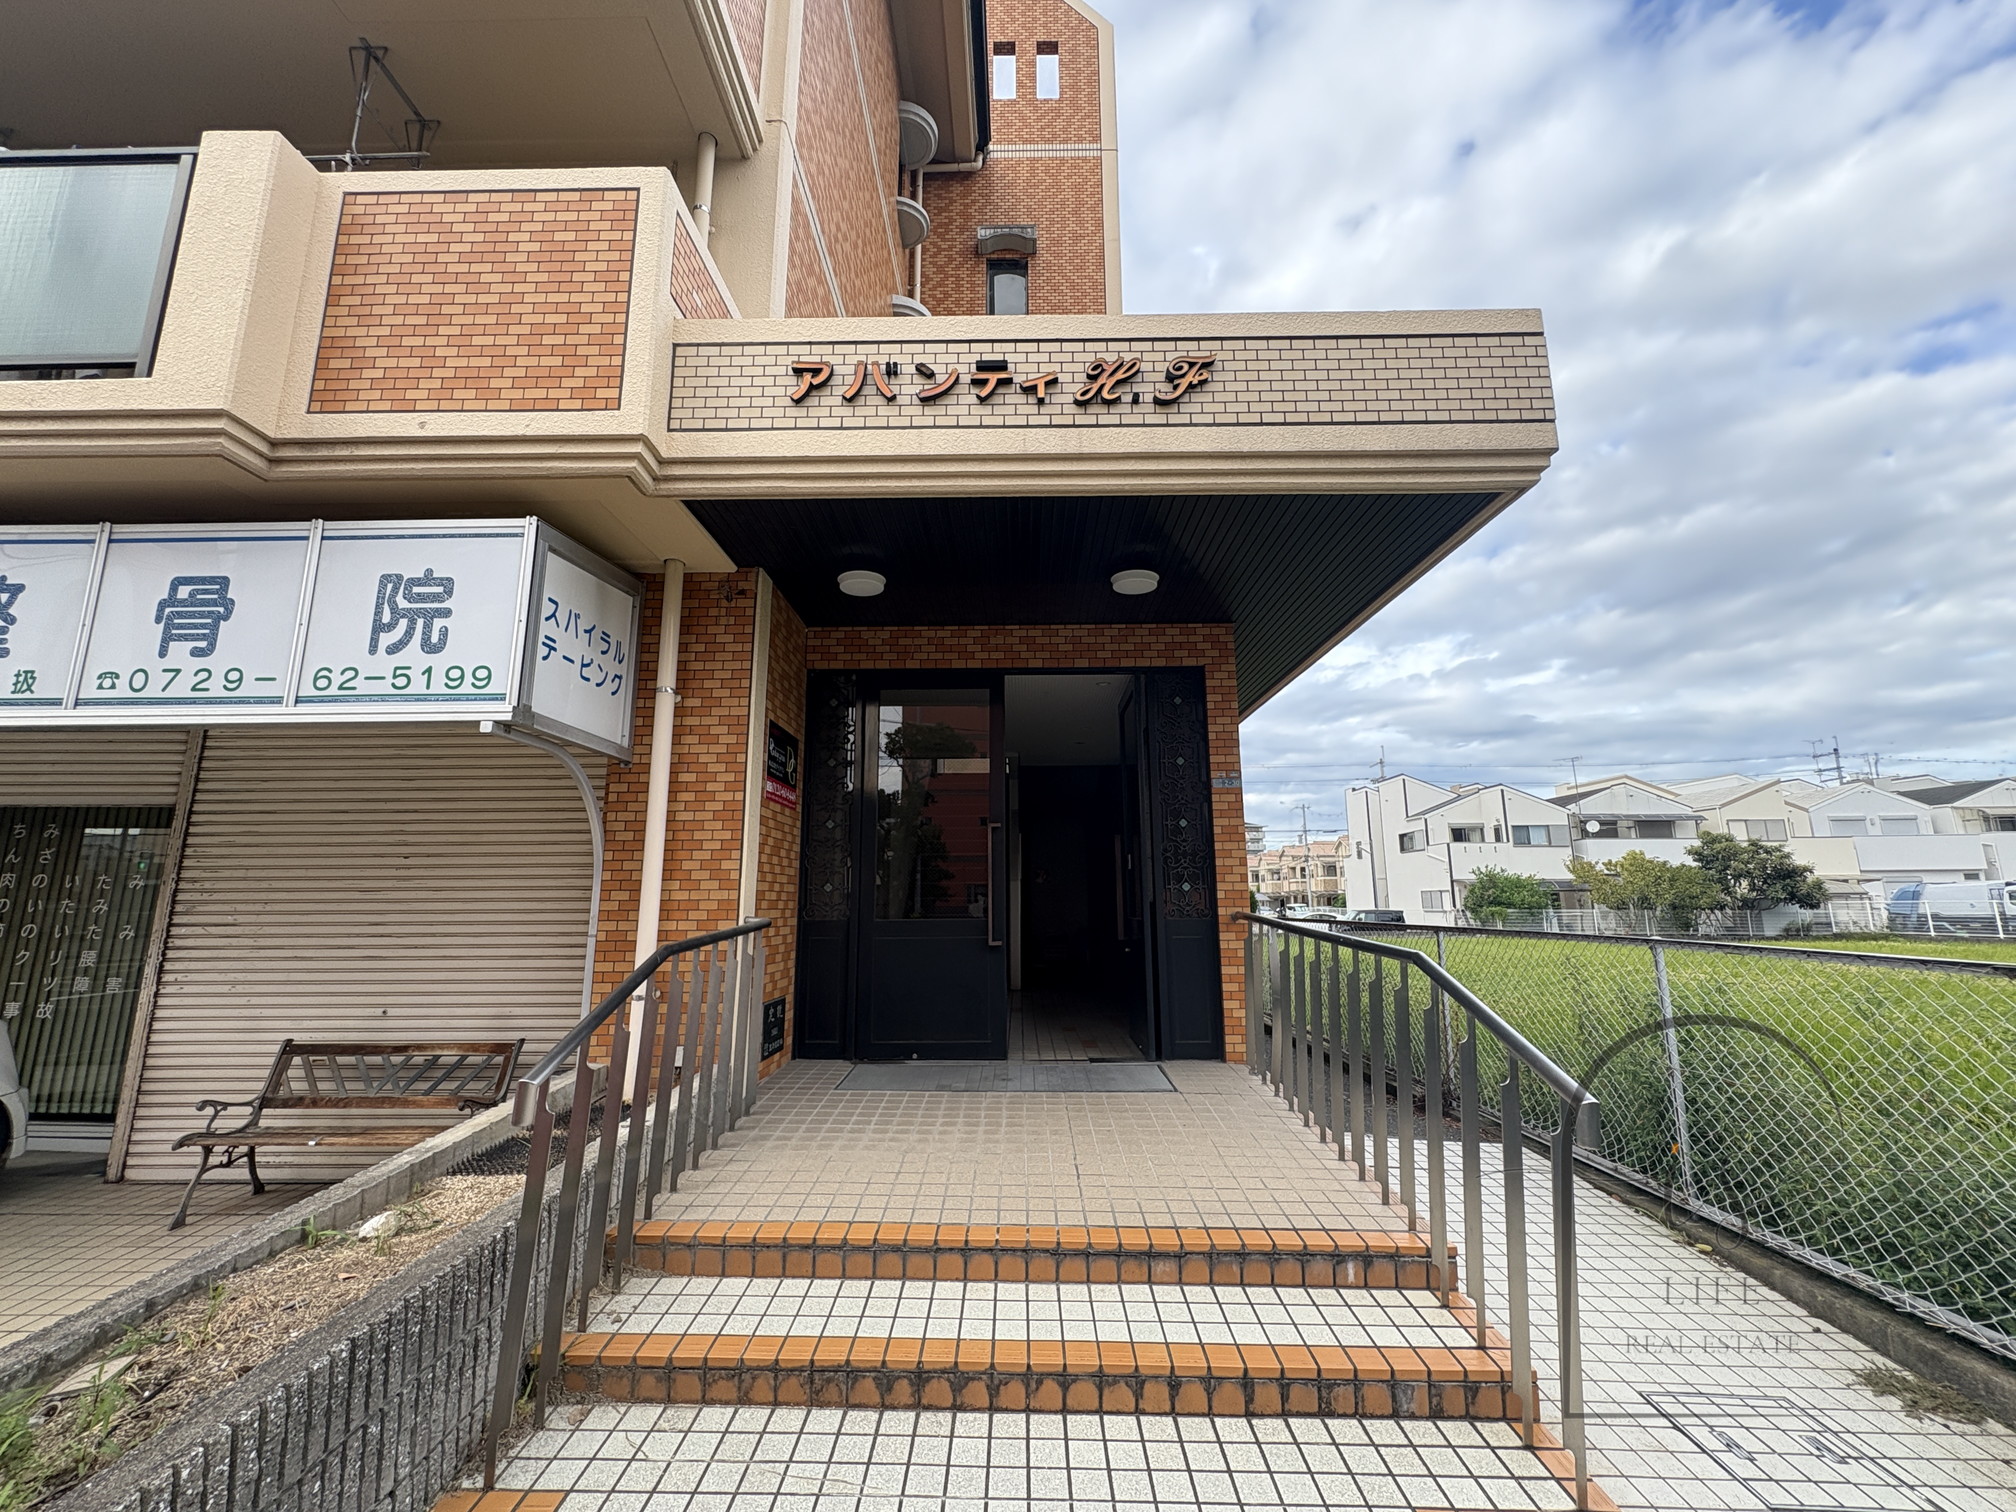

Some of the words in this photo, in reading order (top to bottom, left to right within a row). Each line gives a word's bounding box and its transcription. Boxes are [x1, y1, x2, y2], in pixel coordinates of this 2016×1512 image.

[544, 596, 627, 664] スパイラル
[540, 639, 625, 698] テーピング
[10, 669, 38, 695] 扱
[12, 821, 60, 840] ちみ
[4, 846, 57, 865] んざ
[0, 872, 146, 891] 肉のいたみ
[14, 949, 98, 968] クリ腰
[3, 1001, 55, 1021] 事故
